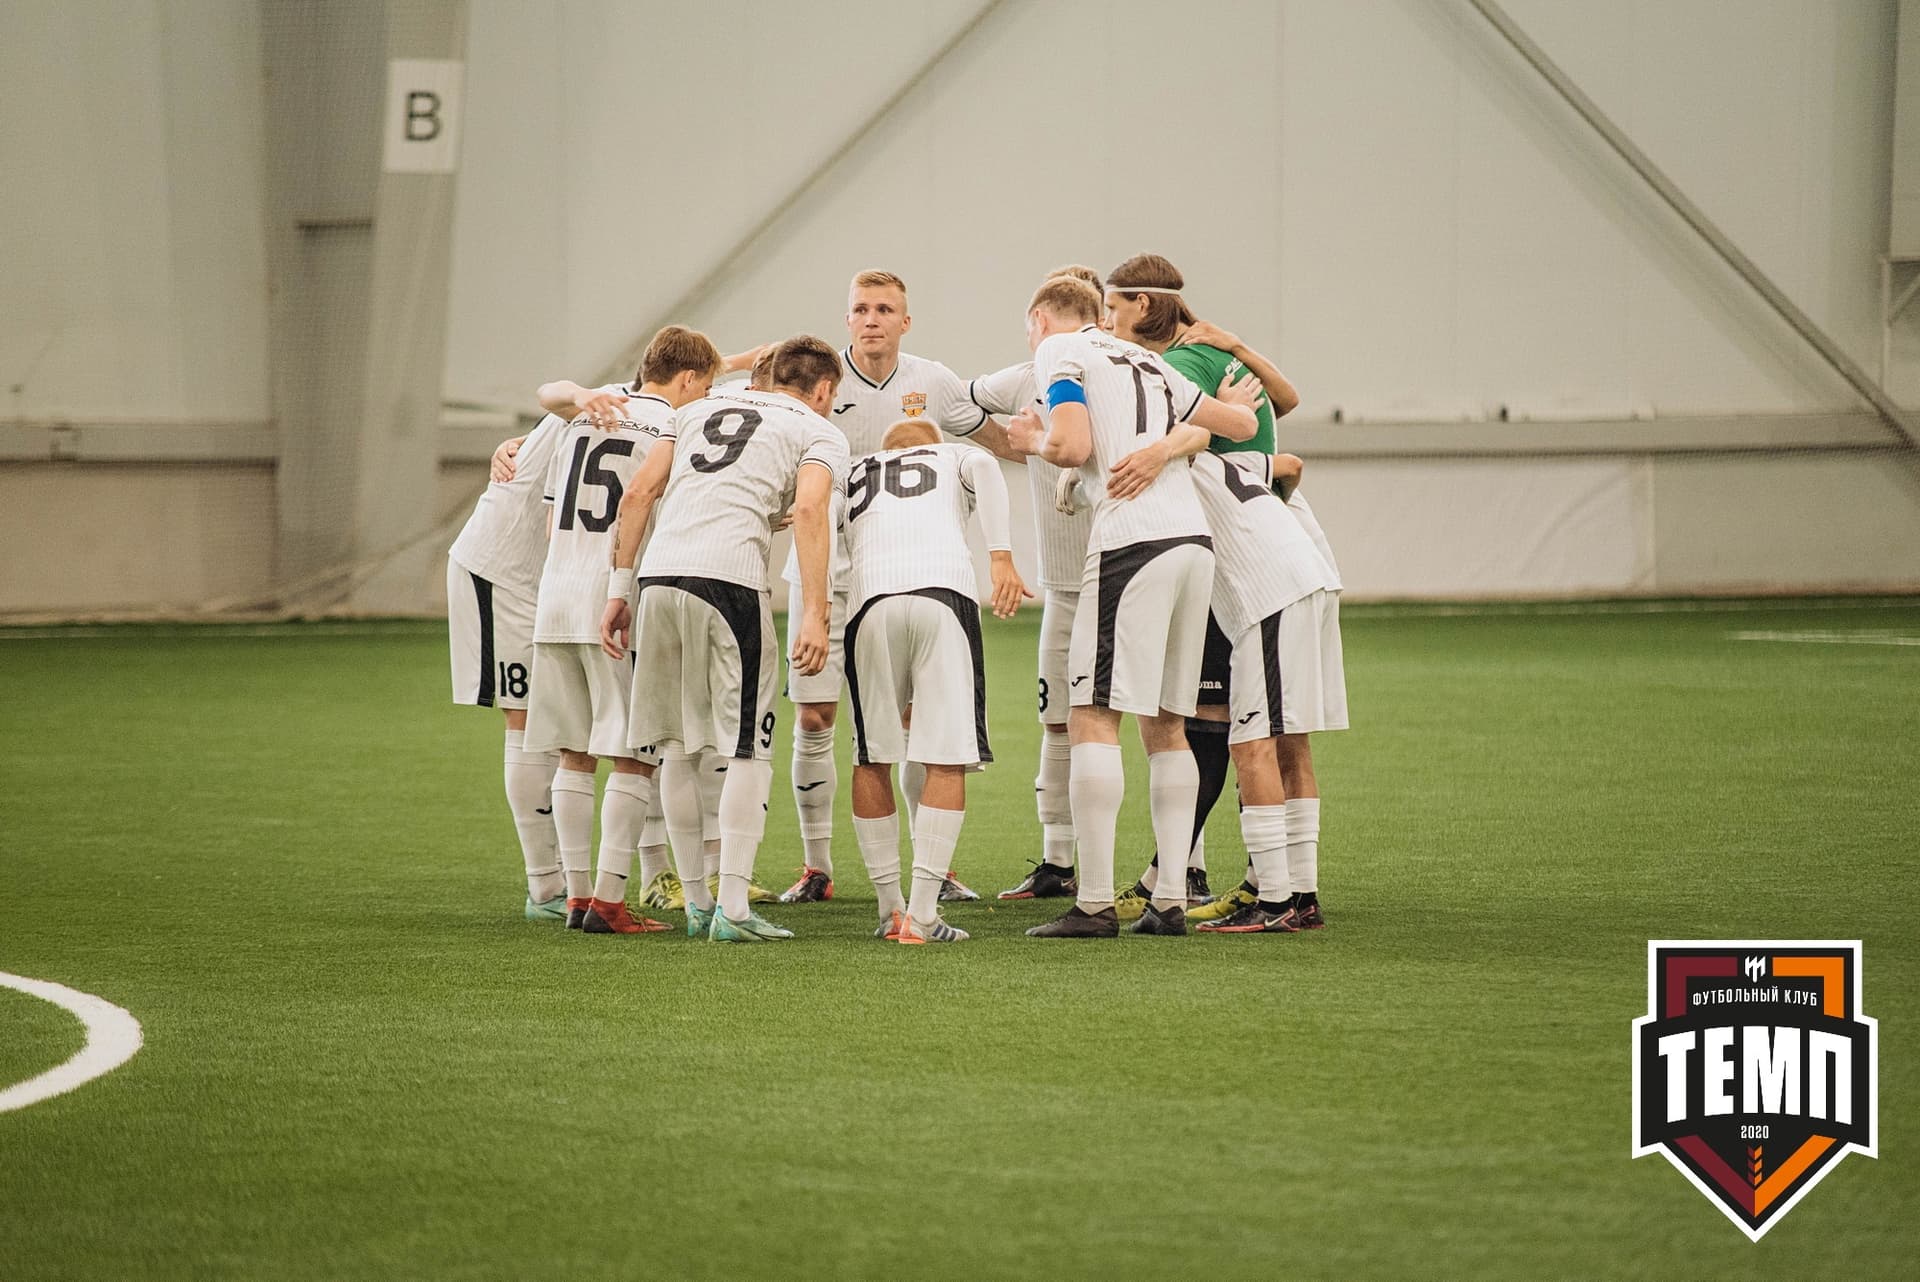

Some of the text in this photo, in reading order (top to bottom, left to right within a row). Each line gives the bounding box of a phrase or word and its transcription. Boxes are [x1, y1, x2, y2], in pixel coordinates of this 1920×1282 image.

[690, 403, 763, 473] 9
[559, 436, 635, 532] 15
[847, 449, 938, 522] 96
[499, 661, 529, 698] 18
[760, 711, 776, 748] 9
